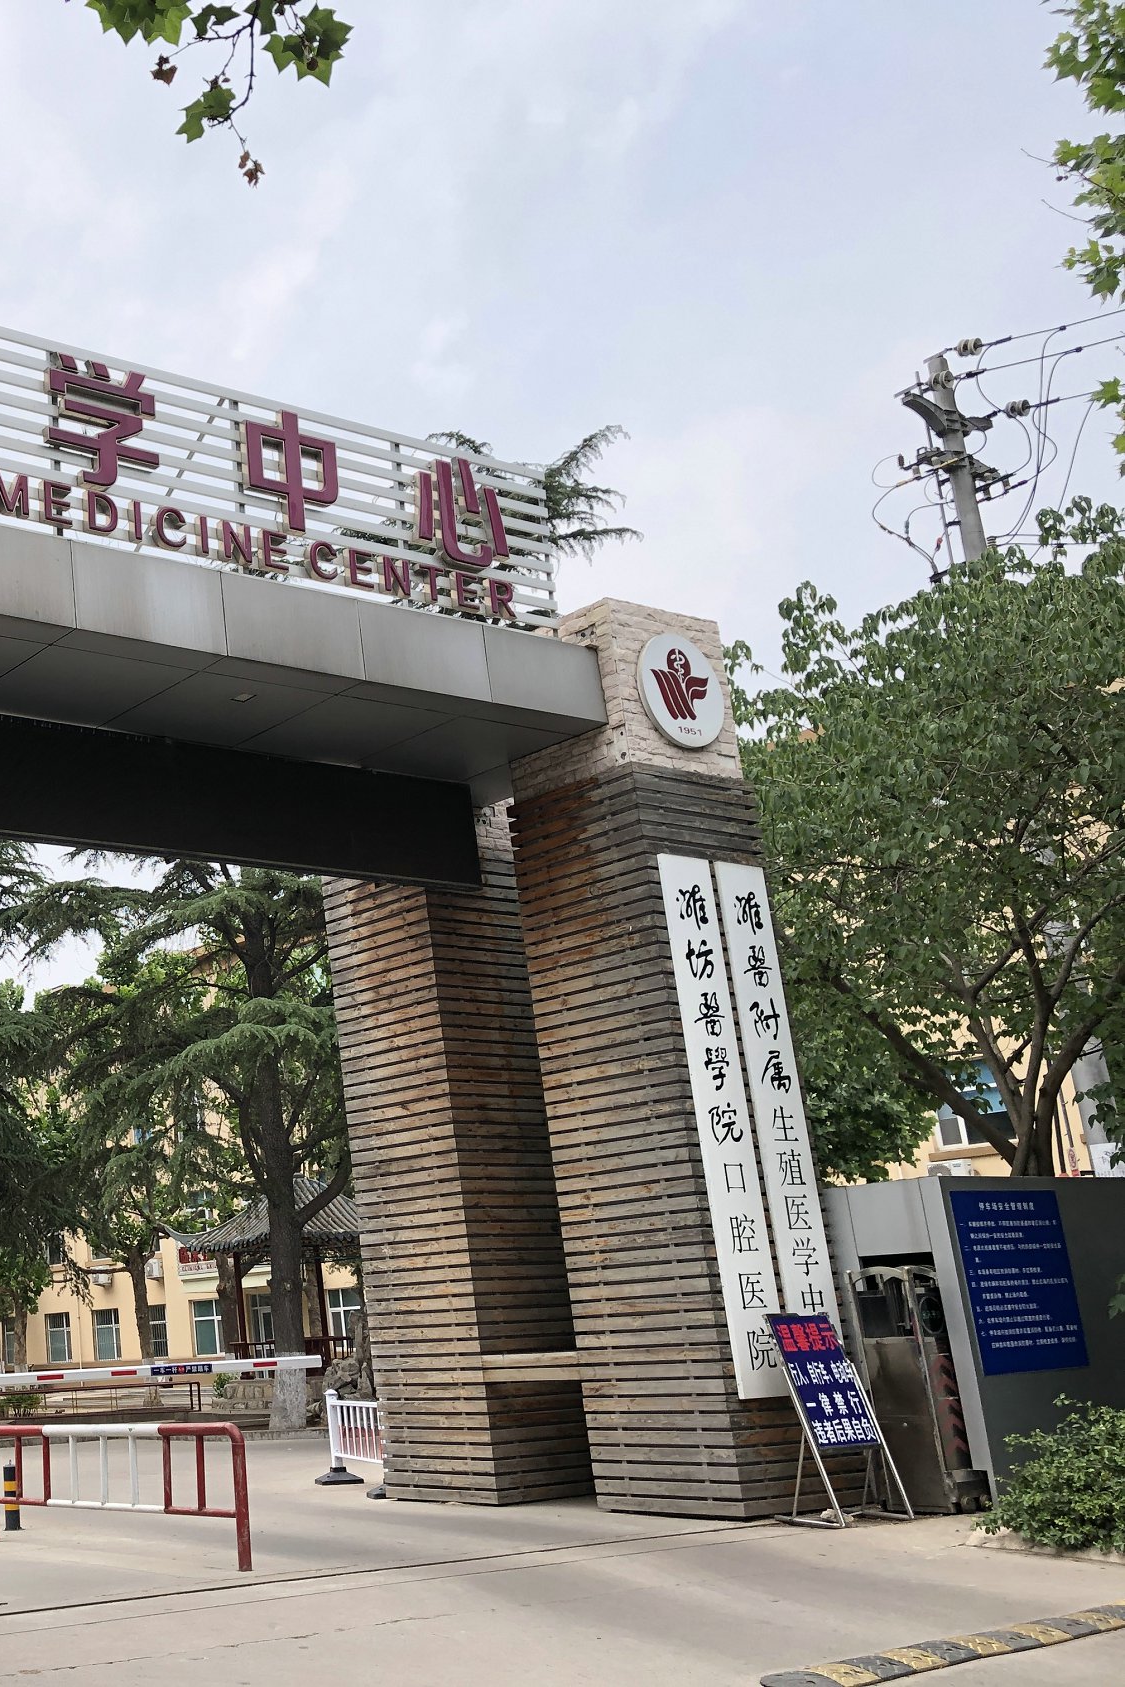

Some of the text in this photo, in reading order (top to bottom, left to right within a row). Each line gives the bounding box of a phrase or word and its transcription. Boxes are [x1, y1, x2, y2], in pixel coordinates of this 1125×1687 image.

[305, 540, 517, 619] CENTER
[678, 726, 702, 736] 1951
[776, 1323, 839, 1352] 温馨提示
[806, 1391, 862, 1417] 一律禁行
[811, 1417, 877, 1444] 违者后果自负
